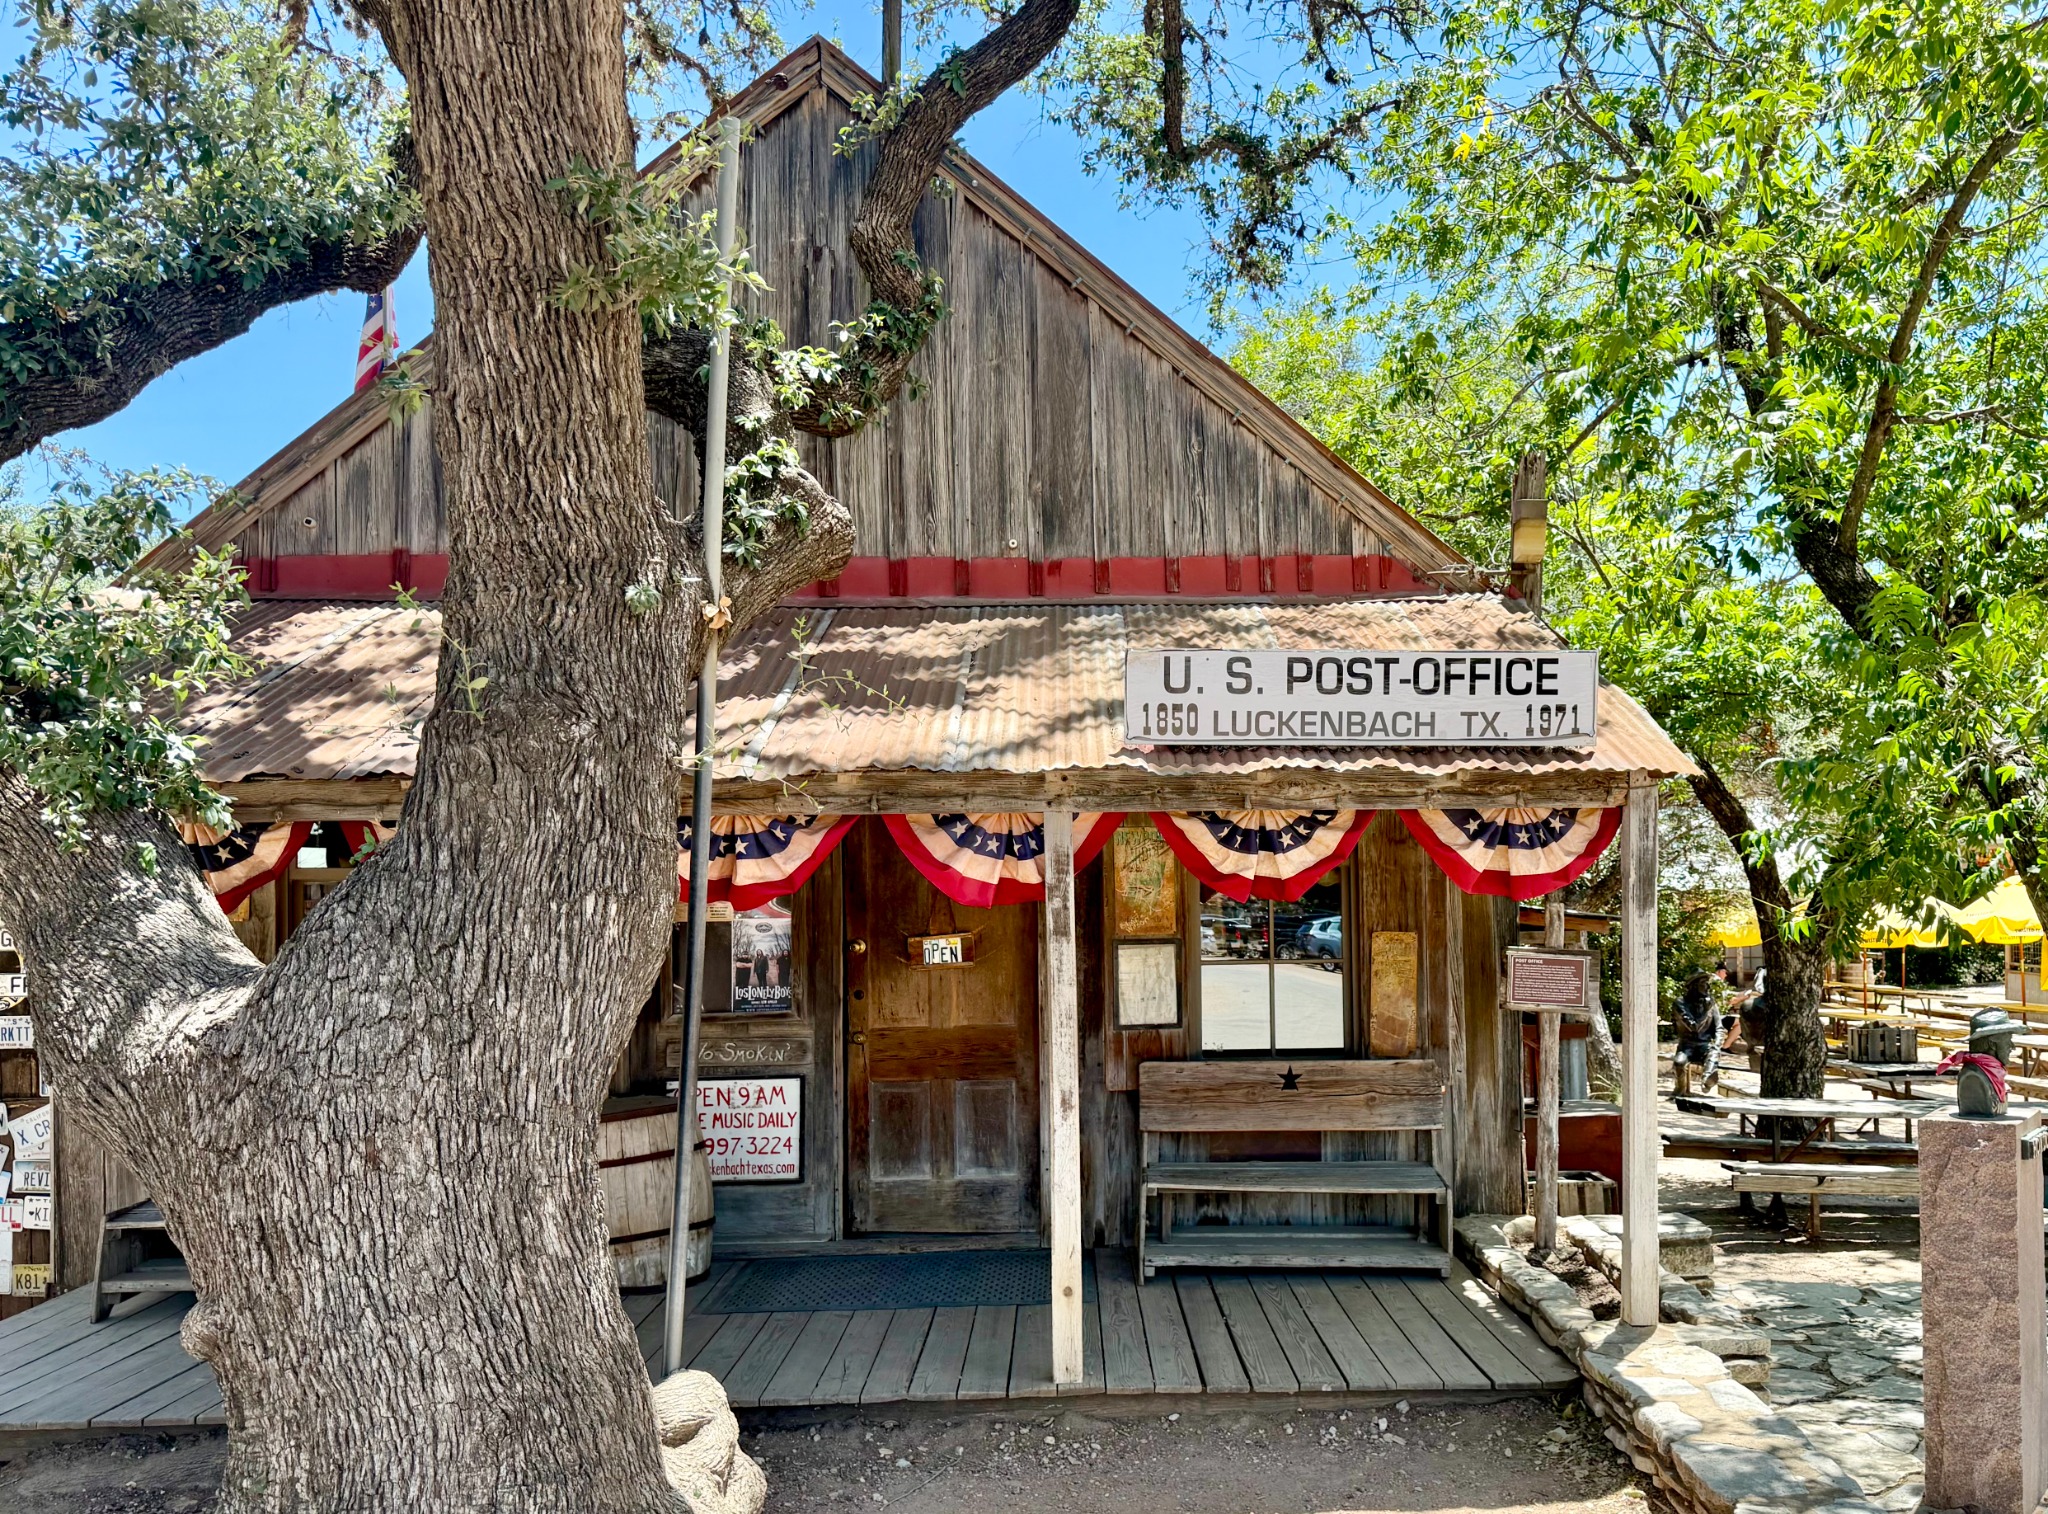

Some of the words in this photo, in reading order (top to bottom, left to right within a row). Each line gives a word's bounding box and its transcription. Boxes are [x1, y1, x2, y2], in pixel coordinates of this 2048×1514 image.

[1163, 656, 1204, 695] U.
[1225, 656, 1264, 695] S.
[1286, 657, 1559, 696] POST-OFFICE
[1142, 702, 1199, 737] 1850
[1213, 710, 1436, 738] LUCKENBACH
[1460, 711, 1509, 738] TX.
[1525, 703, 1580, 737] 1971
[924, 943, 959, 965] OPEN
[738, 1086, 750, 1106] 9
[755, 1085, 786, 1106] AM
[712, 1112, 755, 1130] MUSIC
[757, 1111, 798, 1129] DAILY
[709, 1158, 795, 1176] kenbachtexas.com
[16, 1273, 41, 1290] K81
